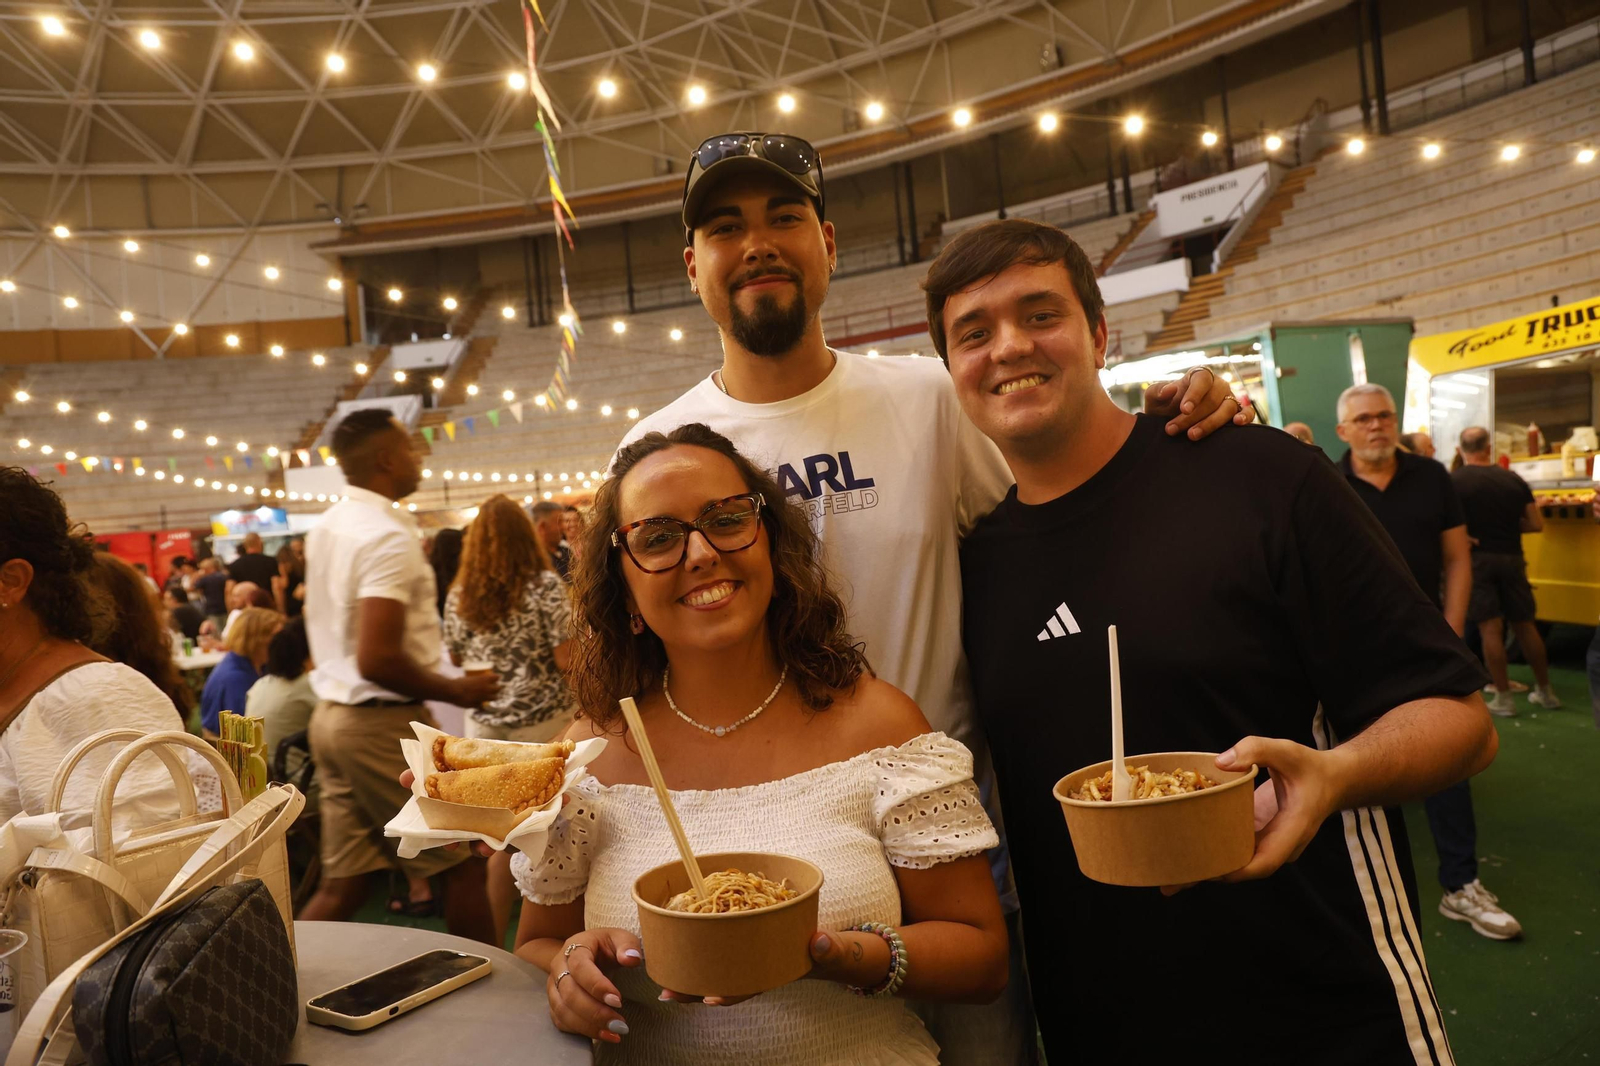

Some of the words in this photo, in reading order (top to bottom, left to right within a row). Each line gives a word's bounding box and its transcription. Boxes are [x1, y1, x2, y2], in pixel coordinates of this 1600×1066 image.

[1181, 180, 1238, 201] PRESIDENCIA
[1448, 324, 1516, 358] Food
[763, 451, 875, 500] ARL
[791, 489, 879, 521] RFELD
